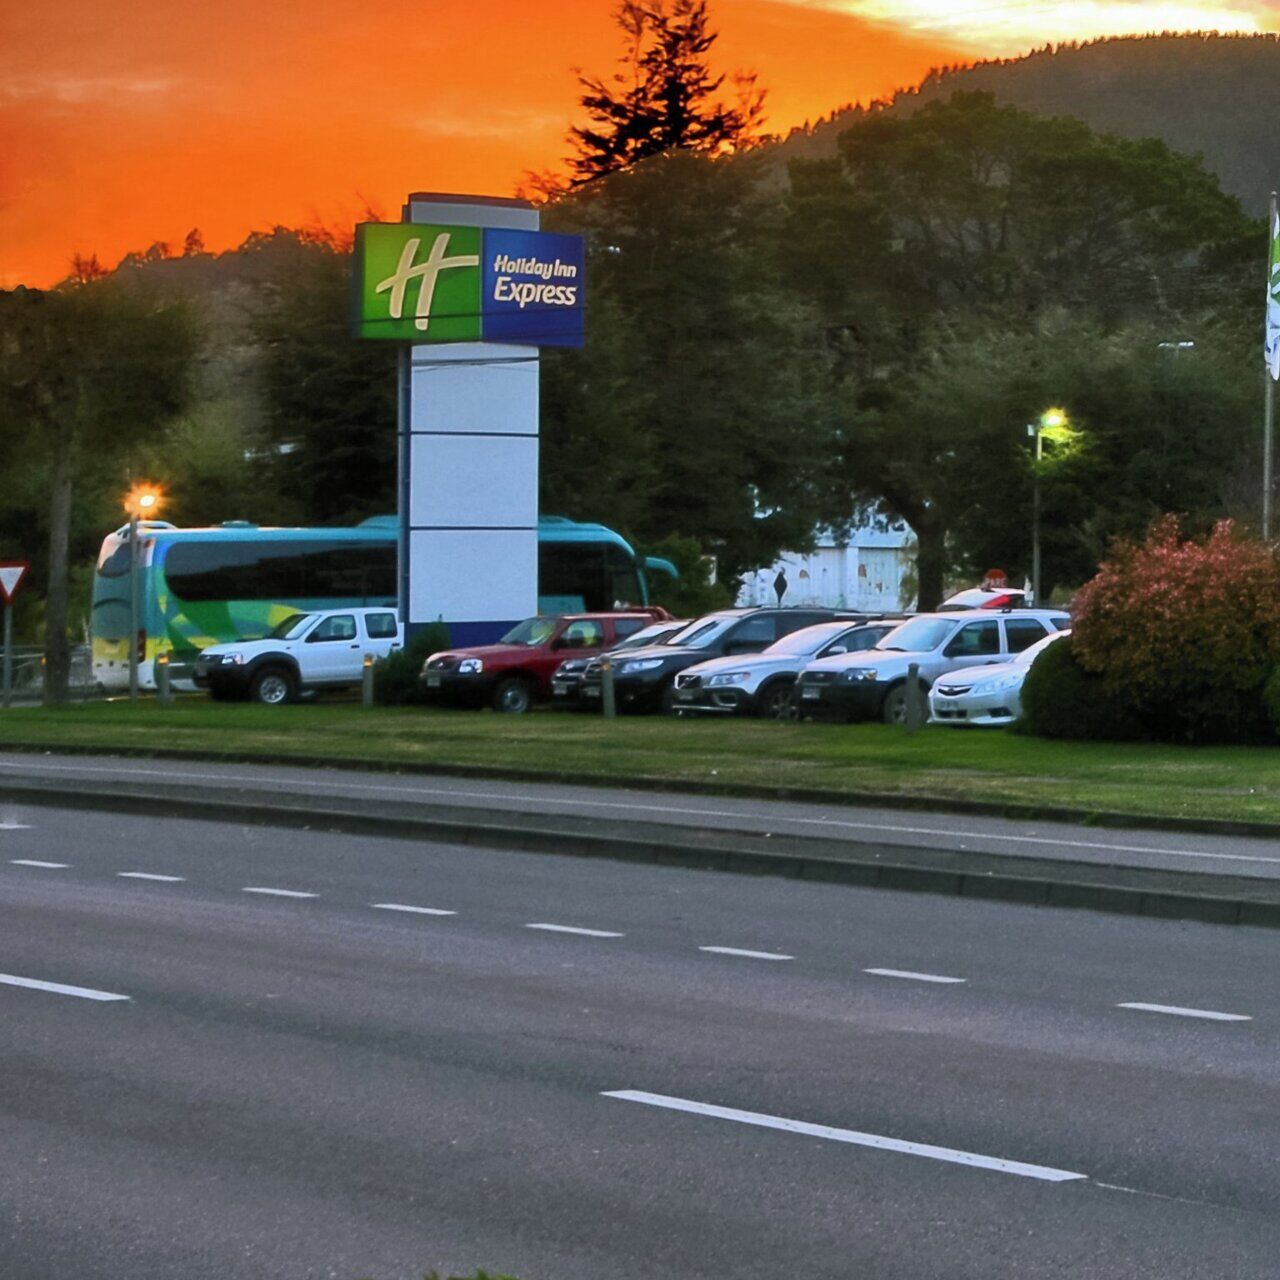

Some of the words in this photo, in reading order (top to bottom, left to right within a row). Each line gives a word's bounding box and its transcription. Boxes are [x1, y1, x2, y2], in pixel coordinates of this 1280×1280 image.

[494, 255, 554, 280] Holiday
[554, 258, 578, 278] Inn
[493, 276, 578, 309] Express
